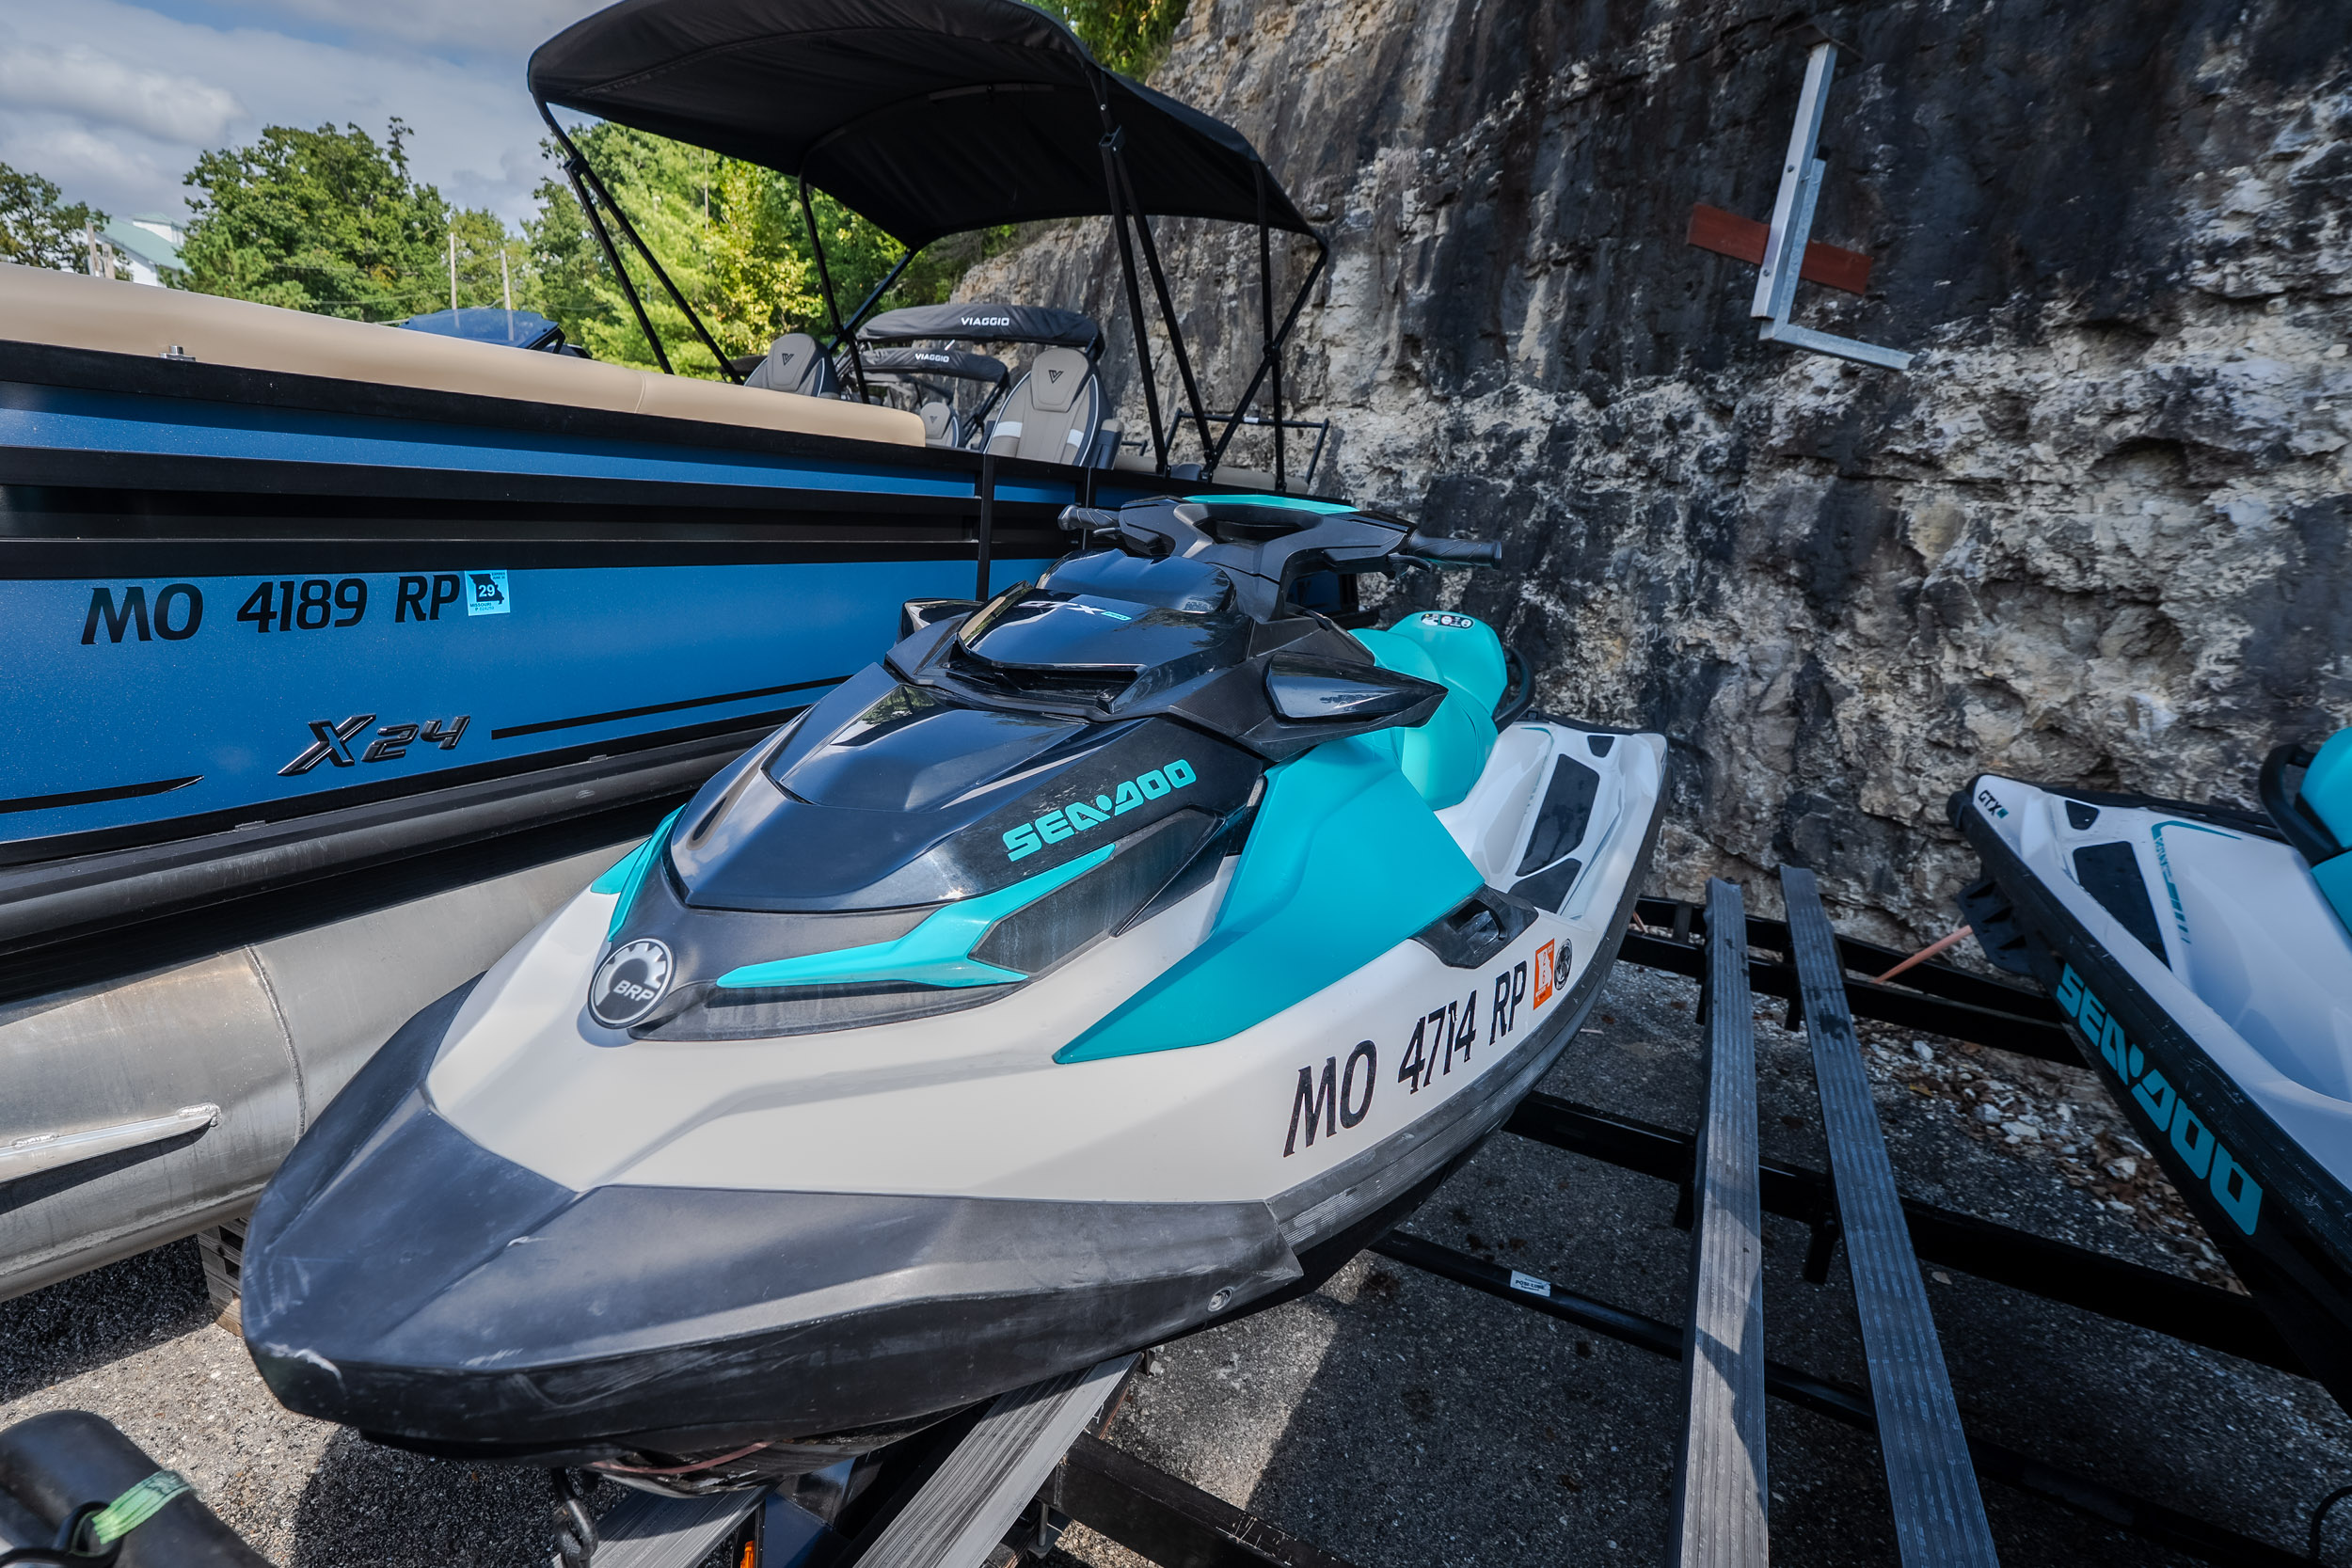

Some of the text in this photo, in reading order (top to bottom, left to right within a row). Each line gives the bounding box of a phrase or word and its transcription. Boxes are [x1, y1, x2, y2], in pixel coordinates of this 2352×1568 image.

[961, 317, 1009, 326] VIAGGIO
[914, 353, 950, 363] VIAGGIO
[478, 584, 496, 597] 29
[81, 574, 460, 645] MO 4189 RP
[278, 714, 471, 776] X24
[1979, 789, 2002, 816] GTX
[613, 979, 655, 1002] BRP
[1283, 960, 1527, 1158] MO 4714 RP
